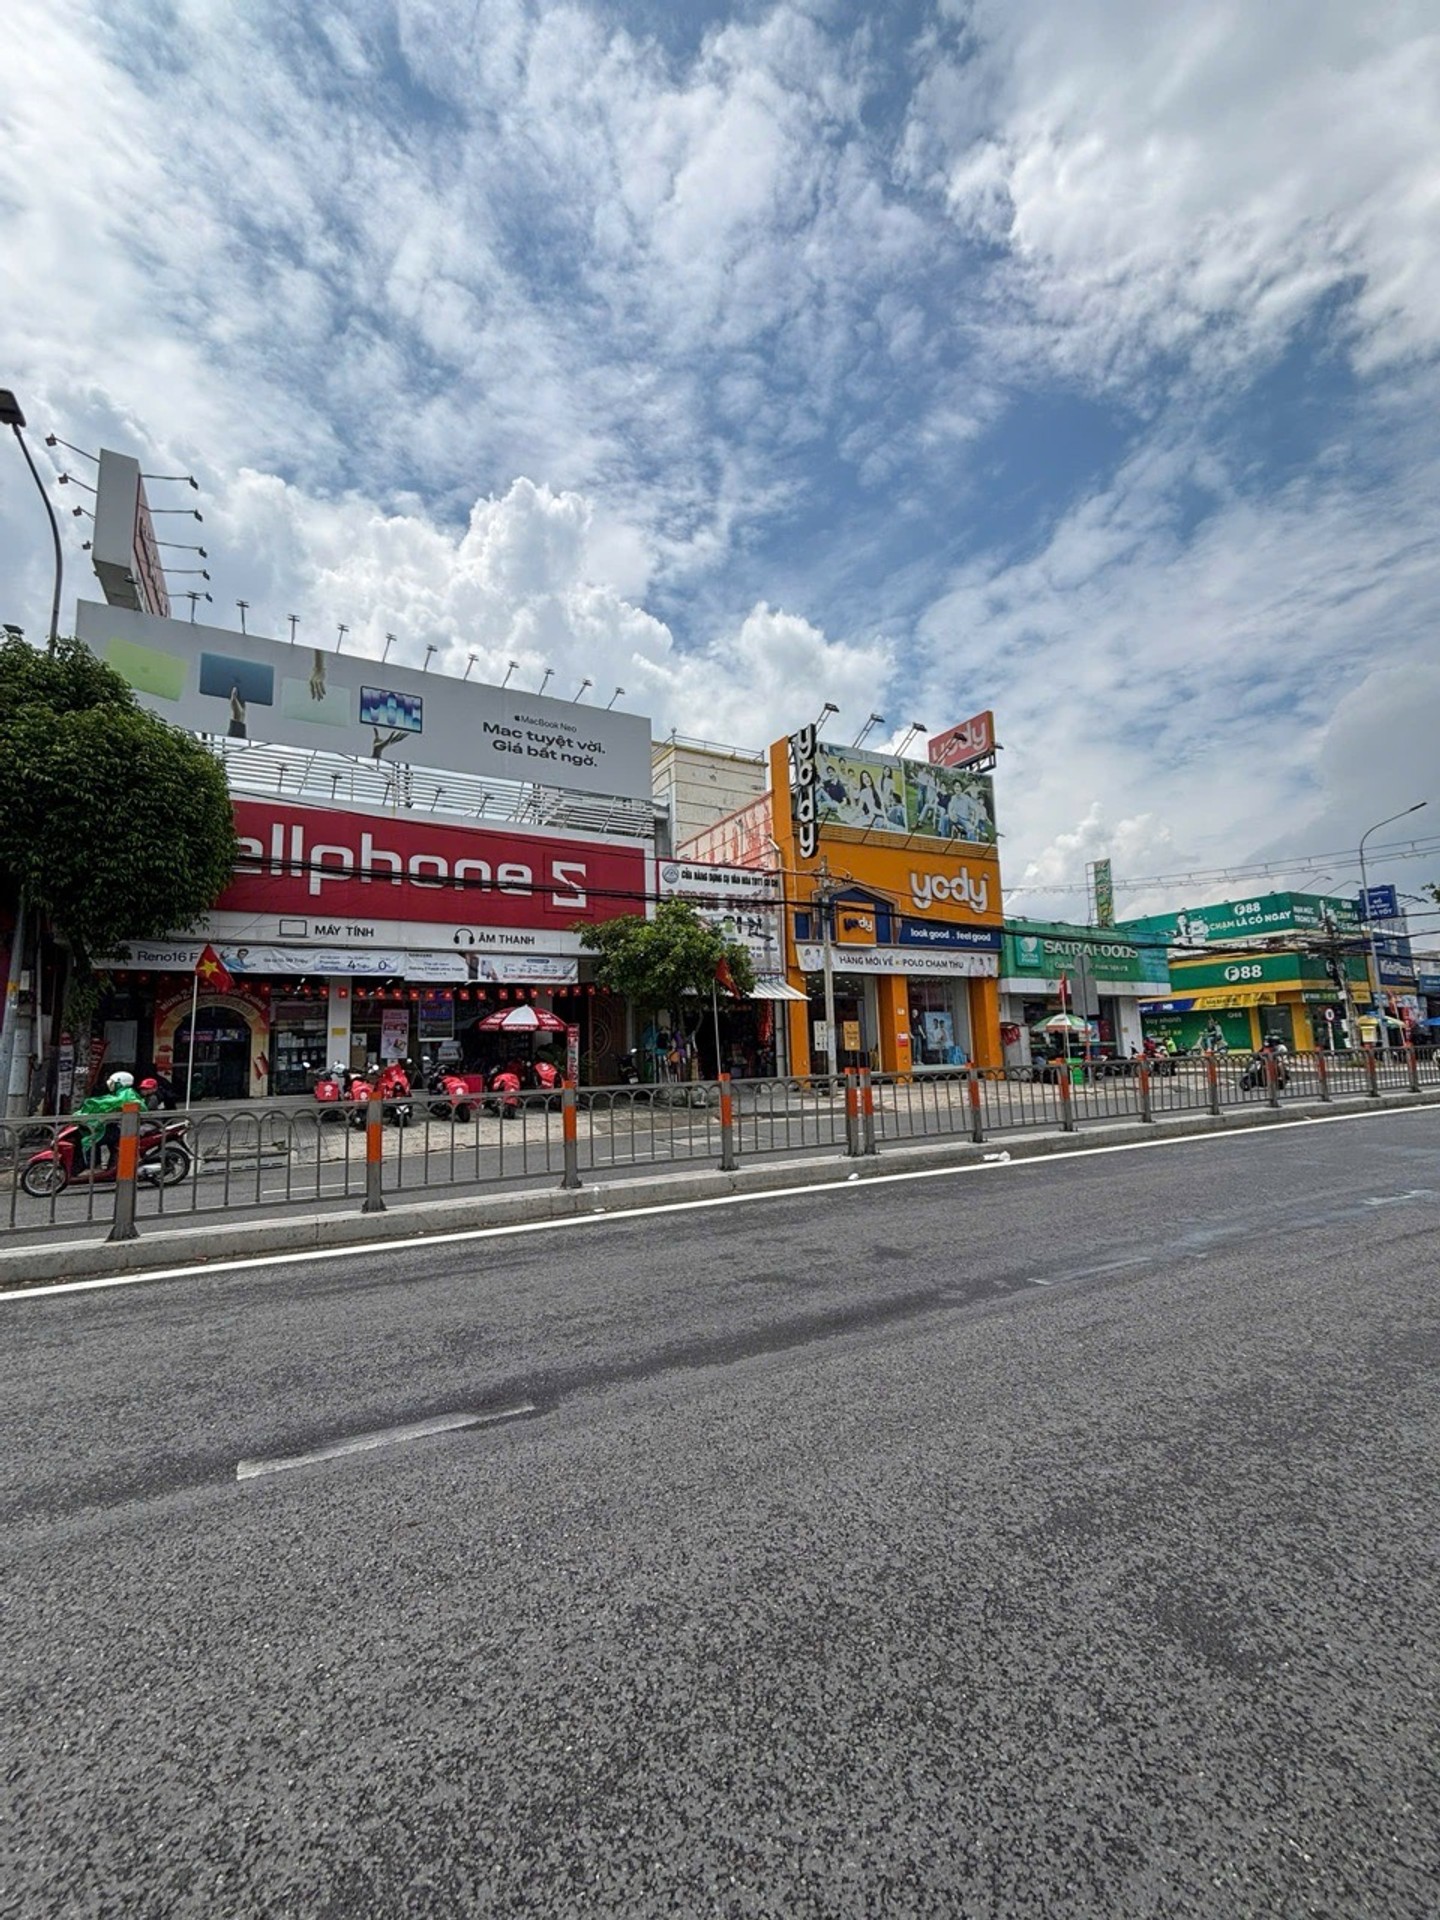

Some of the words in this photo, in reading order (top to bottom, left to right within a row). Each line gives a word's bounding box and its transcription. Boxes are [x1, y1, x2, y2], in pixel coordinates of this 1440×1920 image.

[521, 715, 558, 729] MacBook
[560, 723, 577, 733] Neo
[483, 722, 523, 739] Mac
[526, 731, 574, 748] tuyệt
[577, 741, 606, 754] vời.
[492, 740, 523, 754] Giá
[527, 745, 557, 760] bất
[561, 754, 597, 767] ngờ.
[1265, 909, 1291, 922] NGAY
[315, 924, 341, 935] MÁY
[346, 926, 374, 937] TÍNH
[911, 928, 928, 938] look
[929, 930, 950, 940] good
[956, 931, 973, 940] feel
[973, 933, 991, 942] good
[478, 933, 496, 944] ÂM
[500, 935, 535, 945] THANH
[138, 952, 188, 962] Reno16
[903, 959, 924, 967] POLO
